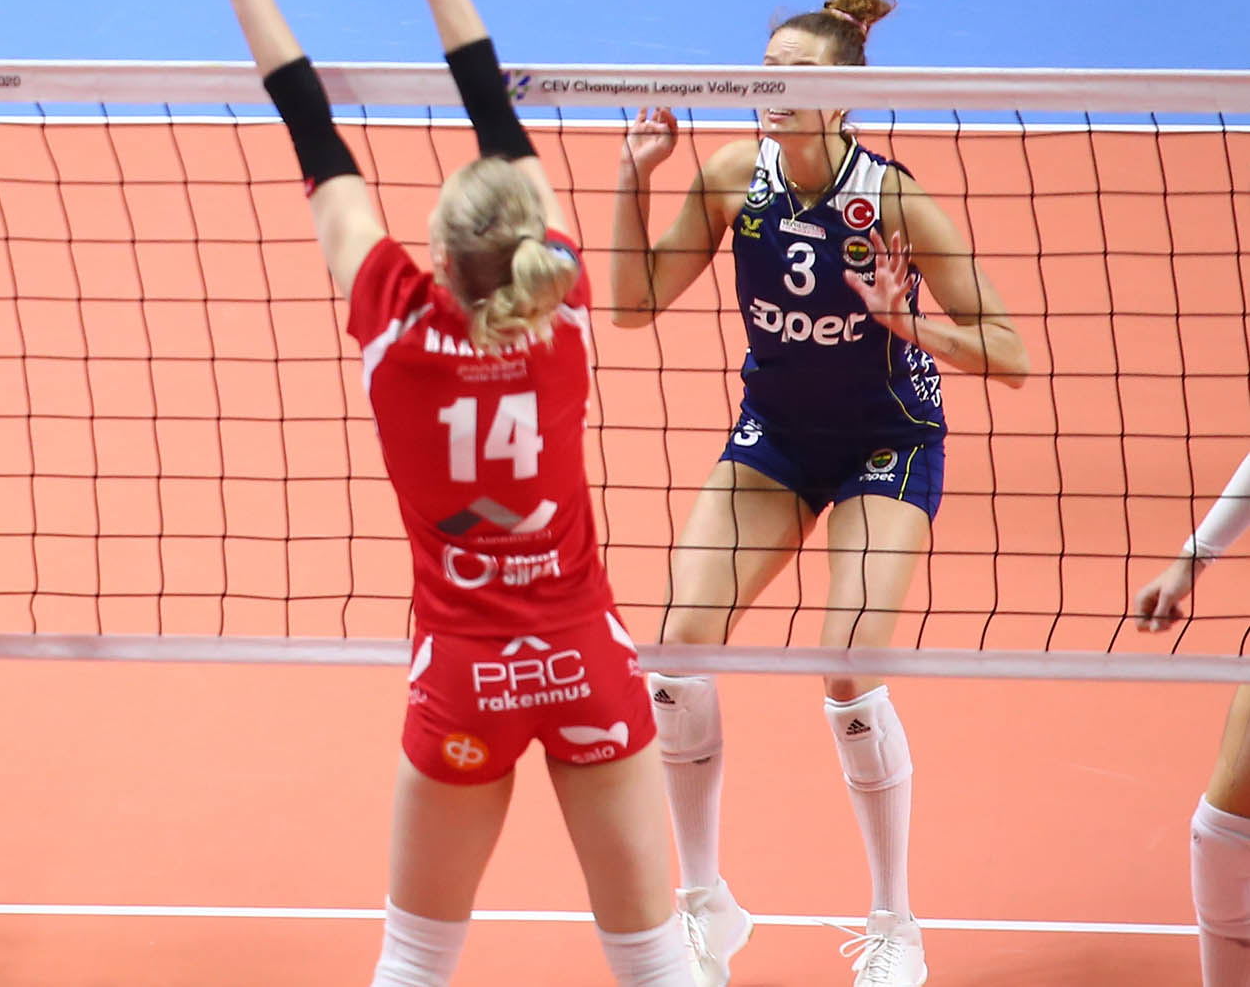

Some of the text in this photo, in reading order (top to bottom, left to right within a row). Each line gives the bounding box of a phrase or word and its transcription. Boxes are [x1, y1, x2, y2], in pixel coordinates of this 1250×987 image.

[541, 79, 787, 97] CEV Champions League Volley 2020
[783, 241, 816, 296] 3
[749, 297, 868, 347] opet
[437, 390, 544, 482] 14
[472, 649, 586, 693] PRC
[477, 681, 592, 711] rakennus
[571, 744, 616, 764] salo
